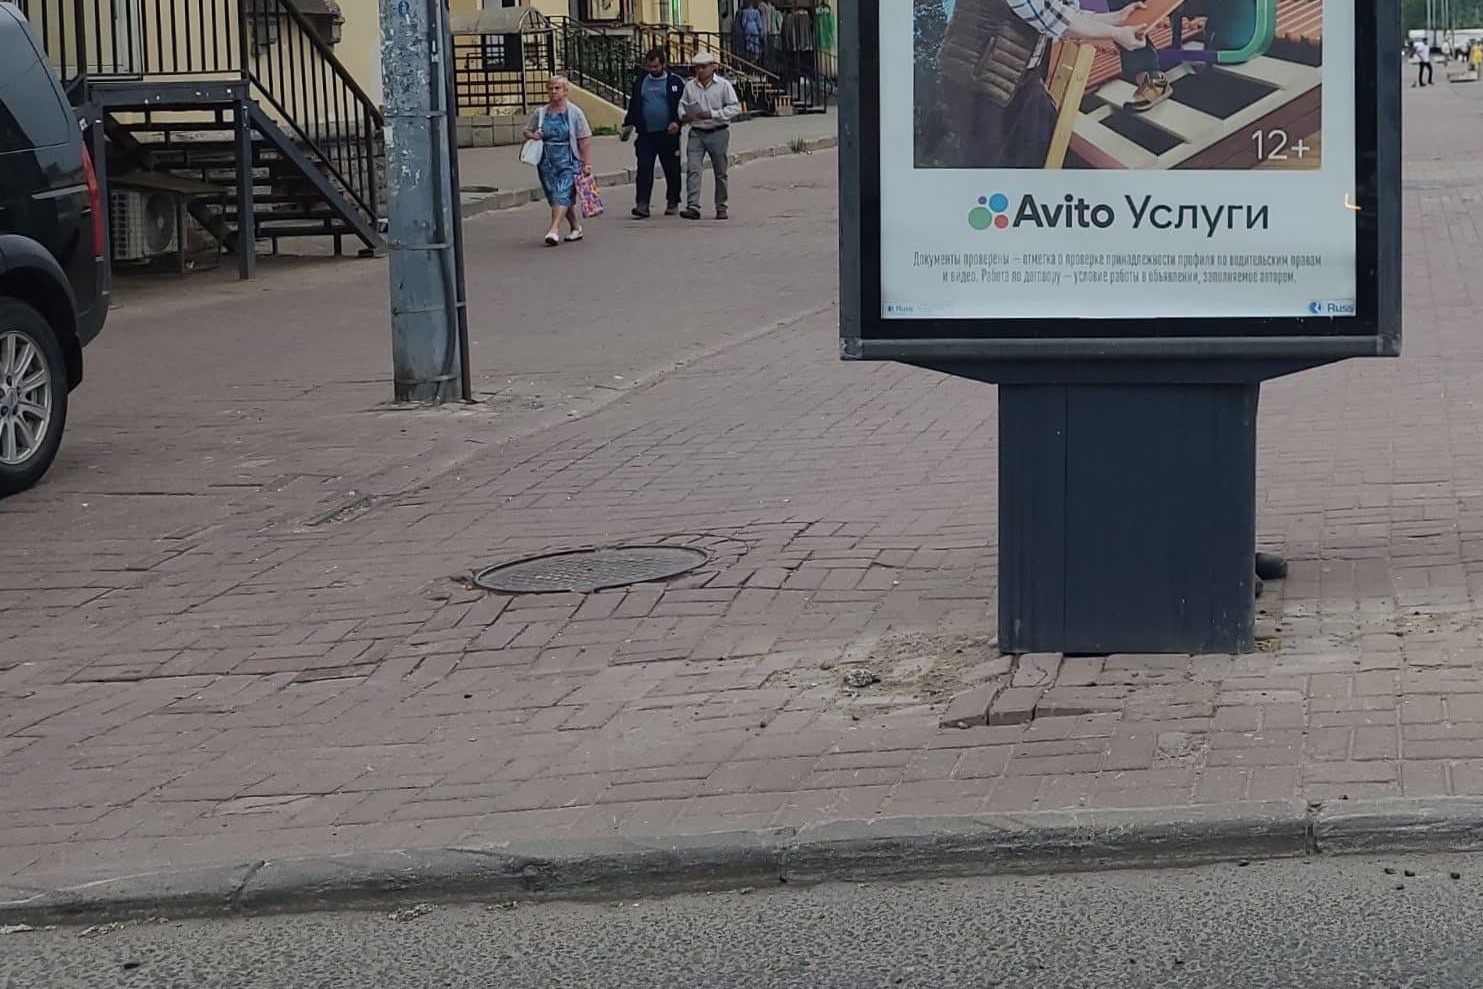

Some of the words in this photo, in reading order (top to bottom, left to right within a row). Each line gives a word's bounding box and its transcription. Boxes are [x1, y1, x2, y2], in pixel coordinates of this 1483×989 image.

[1252, 129, 1311, 161] 12+
[1012, 193, 1115, 228] Avito
[1125, 194, 1269, 238] Услуги
[913, 251, 961, 267] Документы
[963, 252, 1010, 268] проверены
[1023, 253, 1056, 265] отметка
[1057, 254, 1063, 265] о
[1065, 253, 1104, 268] проверке
[1106, 253, 1176, 267] принадлежности
[1178, 253, 1215, 268] профиля
[1217, 254, 1227, 266] по
[1229, 254, 1289, 267] водительским
[1290, 254, 1322, 269] правам
[942, 272, 949, 282] и
[981, 268, 1010, 282] Работа
[1011, 271, 1022, 282] по
[1023, 270, 1061, 285] договору
[1073, 270, 1108, 285] условие
[1110, 269, 1139, 285] работы
[1141, 271, 1147, 283] в
[1203, 271, 1257, 283] заполняемое
